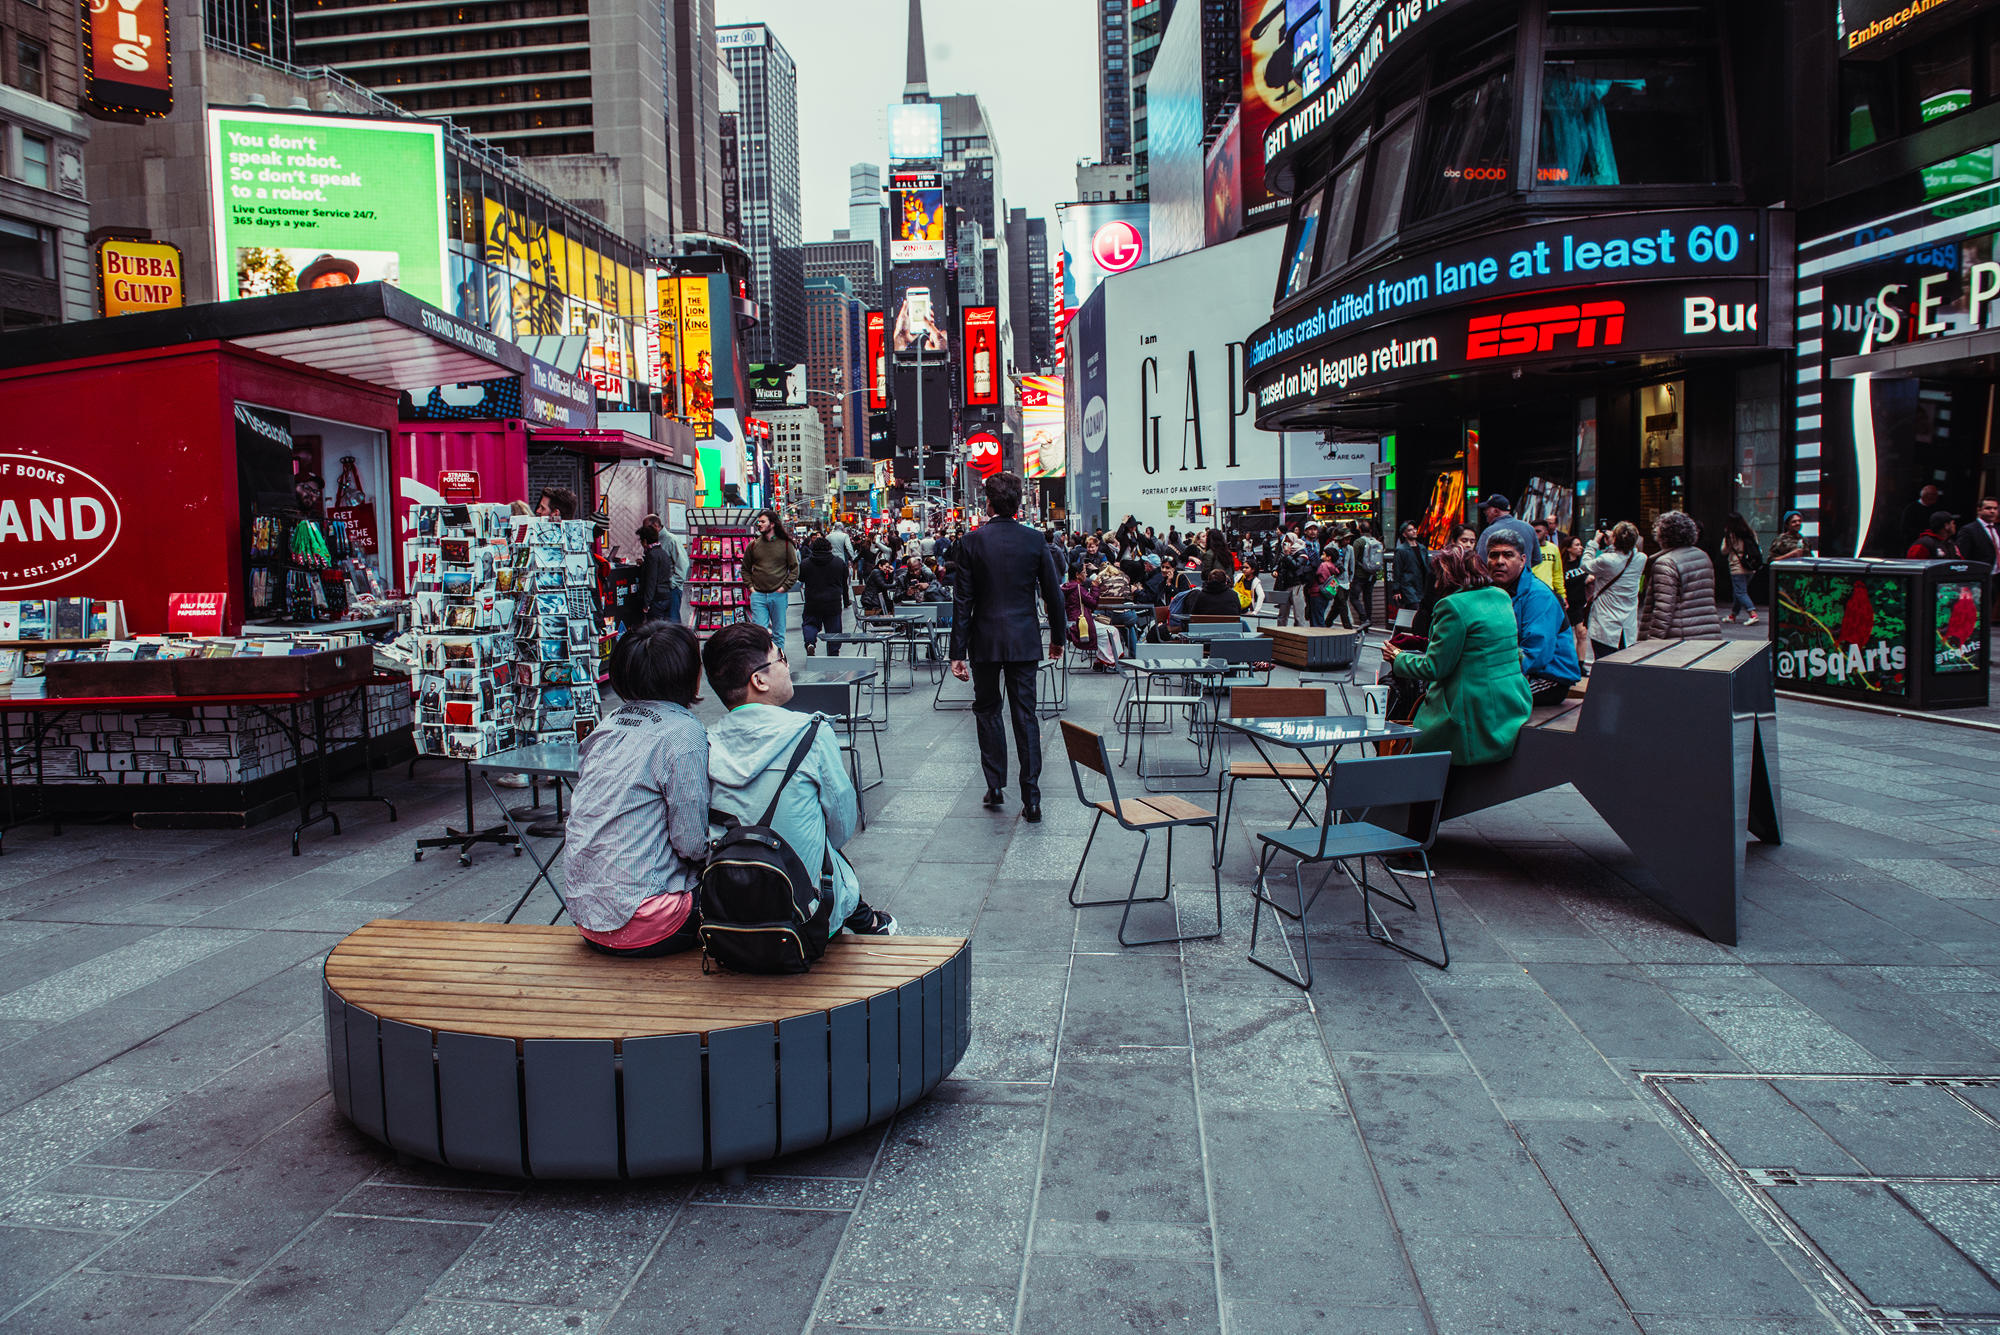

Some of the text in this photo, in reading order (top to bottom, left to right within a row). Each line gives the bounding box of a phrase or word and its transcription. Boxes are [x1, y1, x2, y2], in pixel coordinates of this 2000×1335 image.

[1289, 96, 1326, 142] WITH
[1327, 62, 1360, 118] DAVID
[1360, 24, 1384, 82] MUIR
[1388, 0, 1422, 43] Live
[228, 131, 317, 151] You don't
[229, 151, 342, 169] speak robot.
[230, 167, 362, 188] So don't speak
[720, 136, 736, 213] TIMES
[1444, 169, 1462, 178] abc
[1463, 168, 1507, 181] GOOD
[230, 184, 328, 202] to a robot.
[232, 205, 378, 220] Live Customer Service 24/7,
[1248, 201, 1276, 216] BROADWAY
[233, 216, 253, 225] 365
[256, 217, 281, 228] days
[292, 219, 320, 229] year.
[106, 250, 177, 278] BUBBA
[113, 279, 173, 304] GUMP
[594, 274, 617, 303] THE
[1253, 224, 1739, 365] church bus crash drifted from lane at least 60
[685, 305, 705, 317] LION
[420, 309, 499, 357] STRAND BOOK STORE
[685, 318, 708, 331] KING
[1466, 300, 1626, 361] ESPN
[1145, 334, 1158, 345] am
[1286, 375, 1300, 398] on
[1300, 363, 1318, 397] big
[1320, 352, 1368, 388] league
[1371, 336, 1438, 373] return
[532, 364, 548, 389] The
[548, 370, 571, 397] Official
[571, 385, 590, 405] Guide
[533, 398, 570, 423] nycgo.com
[1141, 341, 1249, 474] GAP
[1085, 416, 1094, 439] OLD
[16, 464, 66, 485] BOOKS
[1142, 487, 1169, 496] PORTRAIT
[1170, 486, 1178, 494] OF
[1178, 486, 1188, 494] AN
[333, 511, 352, 520] GET
[24, 565, 48, 578] EST.
[51, 553, 78, 571] 1927
[1777, 639, 1907, 681] @TSqArts
